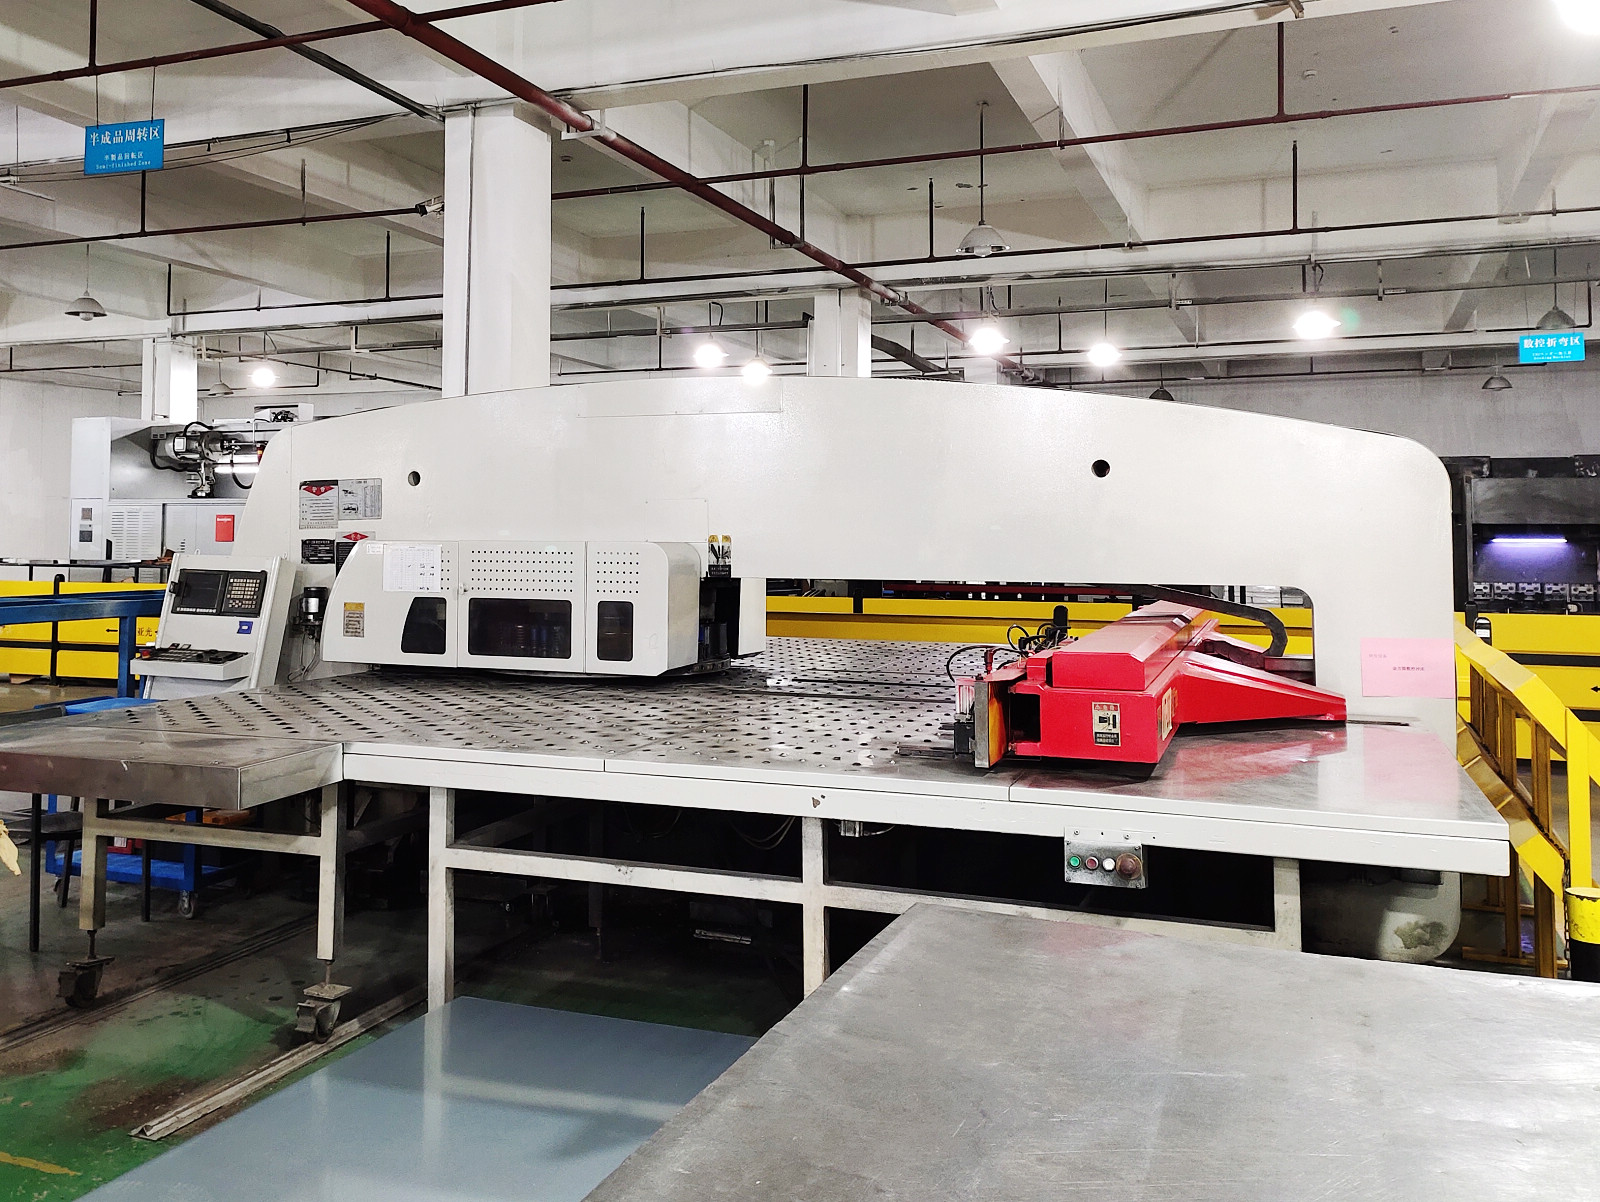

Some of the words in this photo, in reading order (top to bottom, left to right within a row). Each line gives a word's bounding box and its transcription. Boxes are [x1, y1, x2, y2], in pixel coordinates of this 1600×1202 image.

[90, 125, 160, 147] 半成品周转区
[1523, 336, 1580, 348] 数控折弯区
